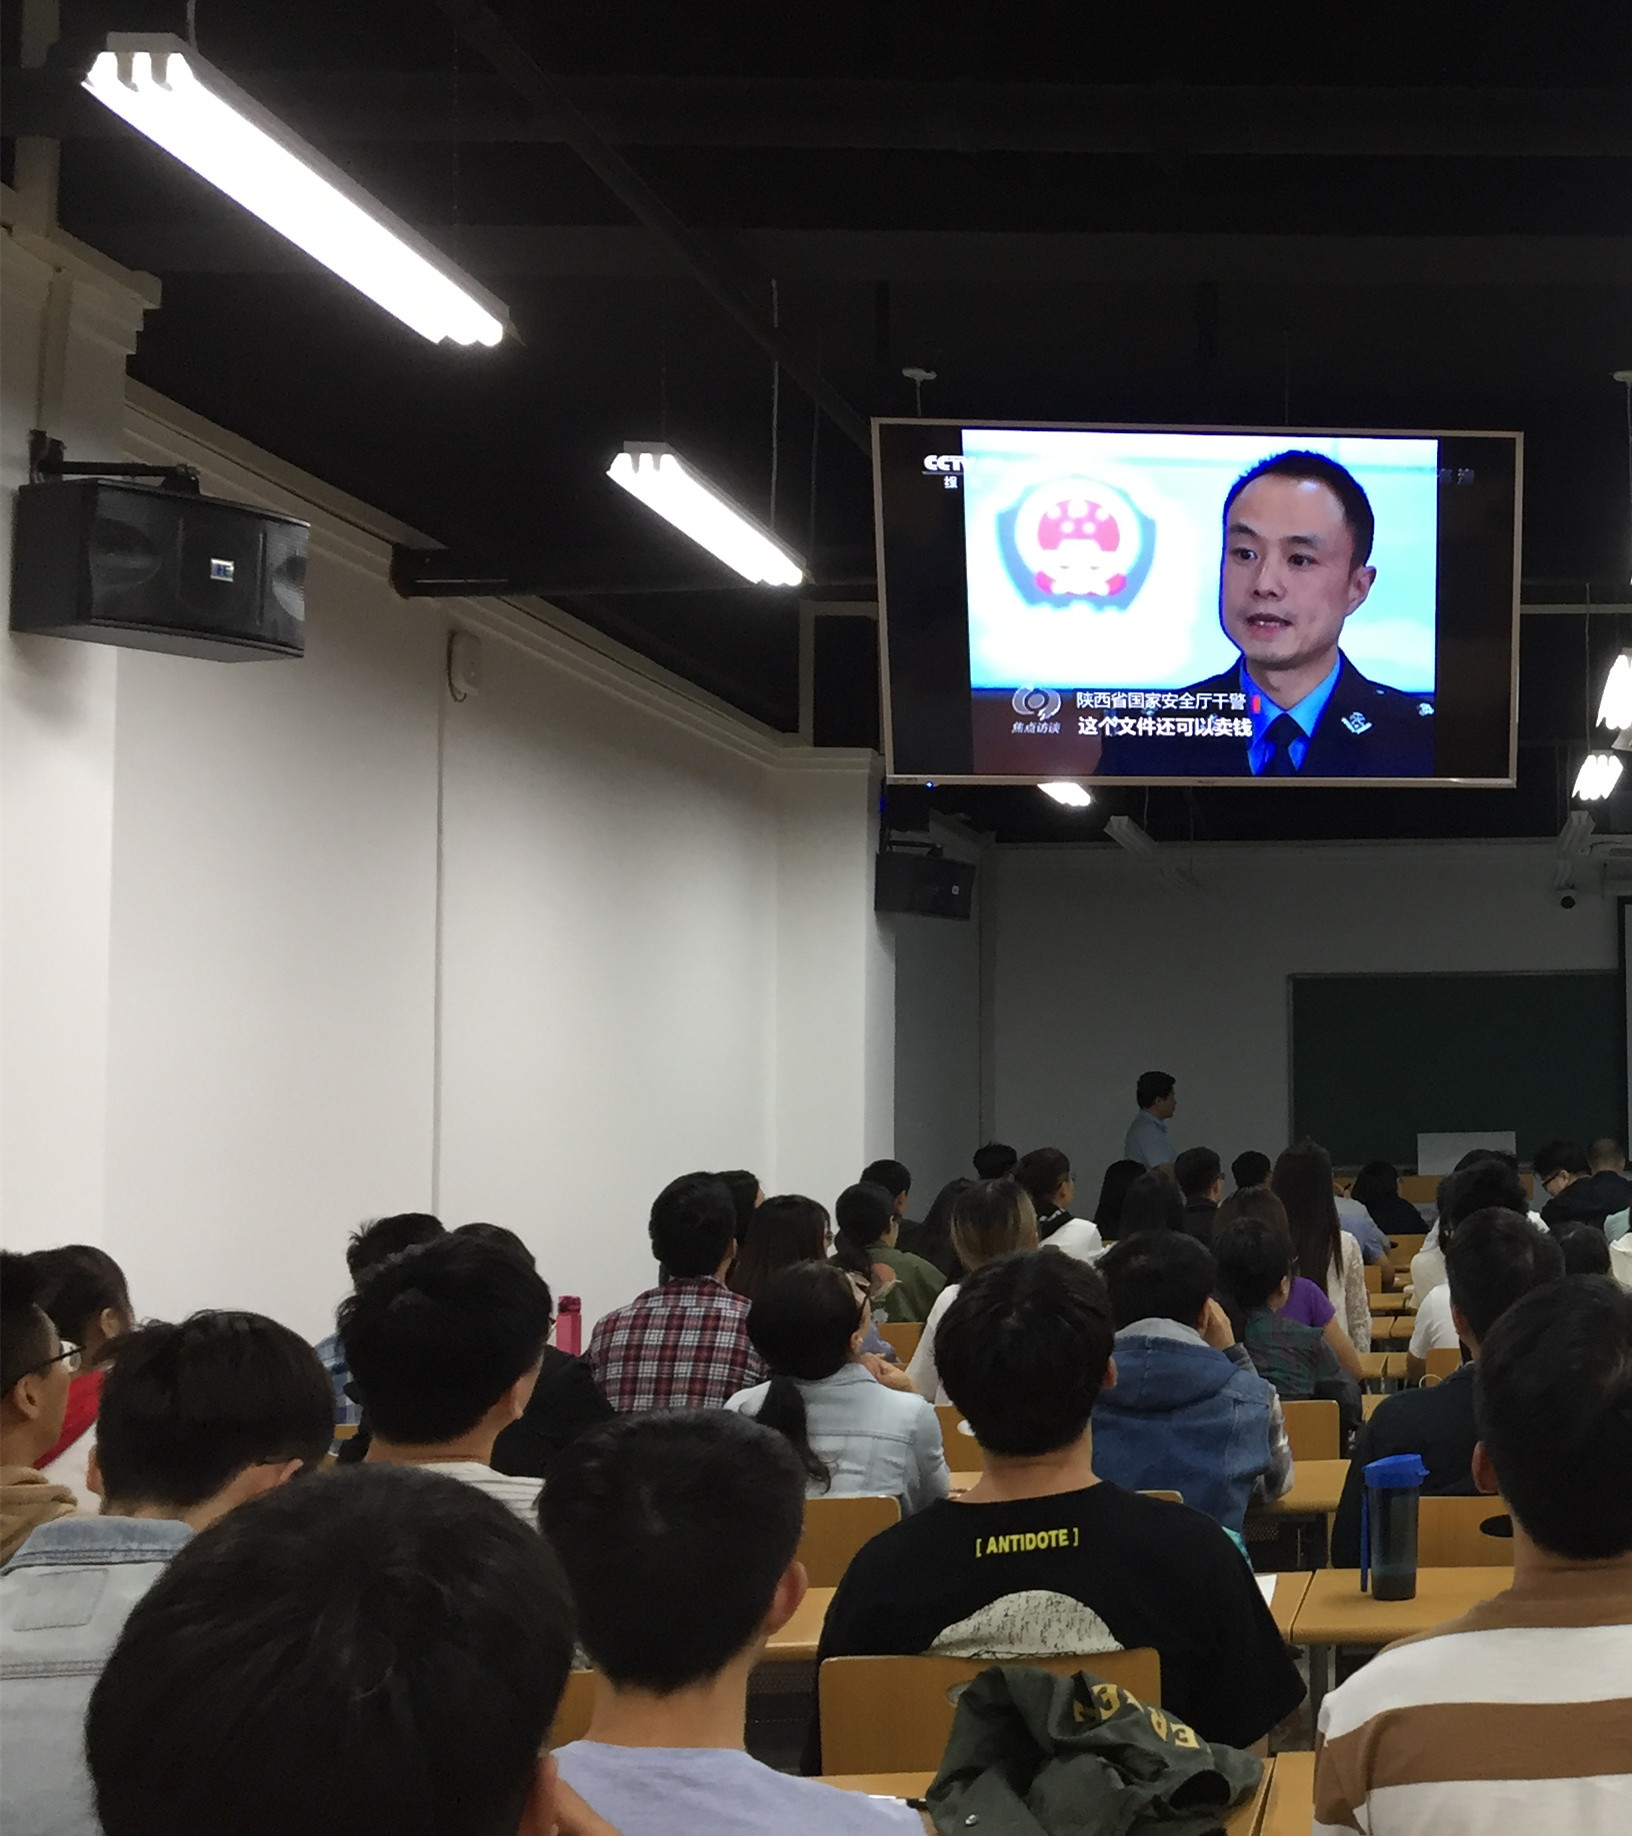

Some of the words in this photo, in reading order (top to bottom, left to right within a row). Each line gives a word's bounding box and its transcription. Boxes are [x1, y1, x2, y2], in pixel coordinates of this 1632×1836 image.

[1076, 692, 1247, 710] 陕西省国家安全厅干警
[1077, 716, 1253, 737] 这个文件还可以卖钱
[986, 1528, 1070, 1554] ANTIDOTE
